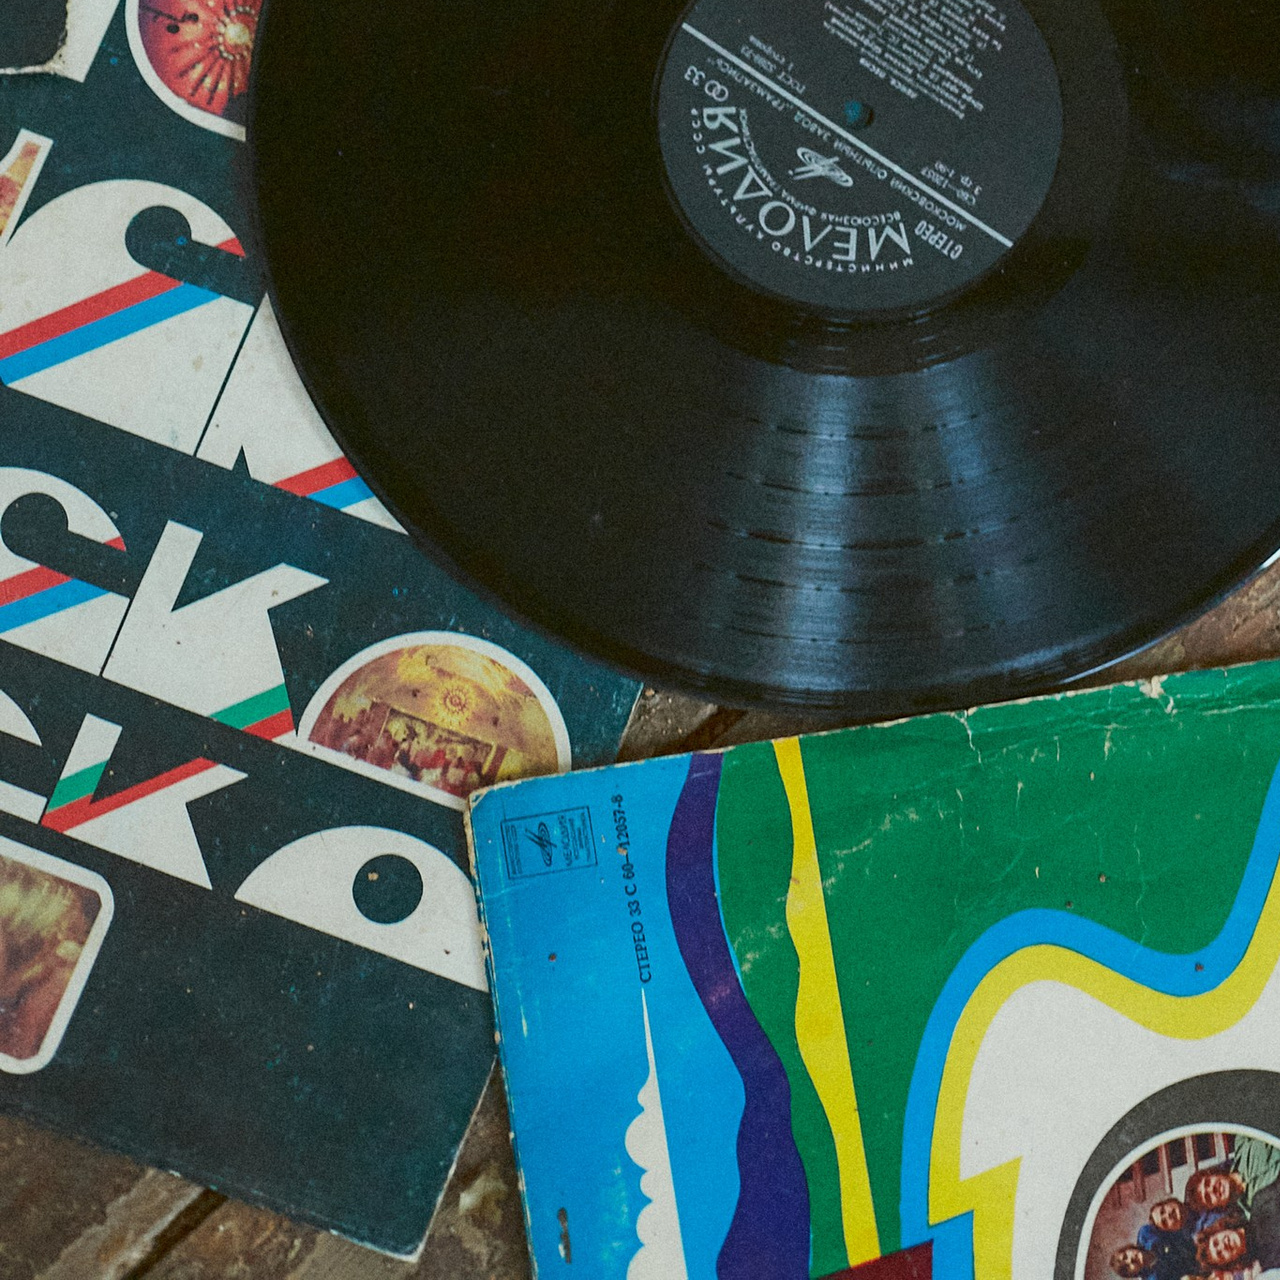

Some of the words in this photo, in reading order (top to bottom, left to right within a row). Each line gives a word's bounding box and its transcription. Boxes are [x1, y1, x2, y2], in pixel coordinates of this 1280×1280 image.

[682, 63, 706, 85] 33
[776, 68, 808, 93] ГОСТ
[690, 108, 707, 154] СССР
[791, 108, 833, 141] ЗАВОД
[831, 136, 888, 180] ОПЫТНЫЙ
[701, 163, 764, 240] КУЛЬТУРЫ
[703, 102, 911, 262] МЕЛОДИЯ
[780, 187, 818, 214] ФИРМА
[887, 175, 968, 232] МОСКОВСКИЙ
[771, 239, 914, 275] МИНИСТЕРСТВО
[913, 218, 964, 261] СТЕРЕО
[628, 900, 644, 920] 33
[631, 922, 652, 983] СТЕРЕО
